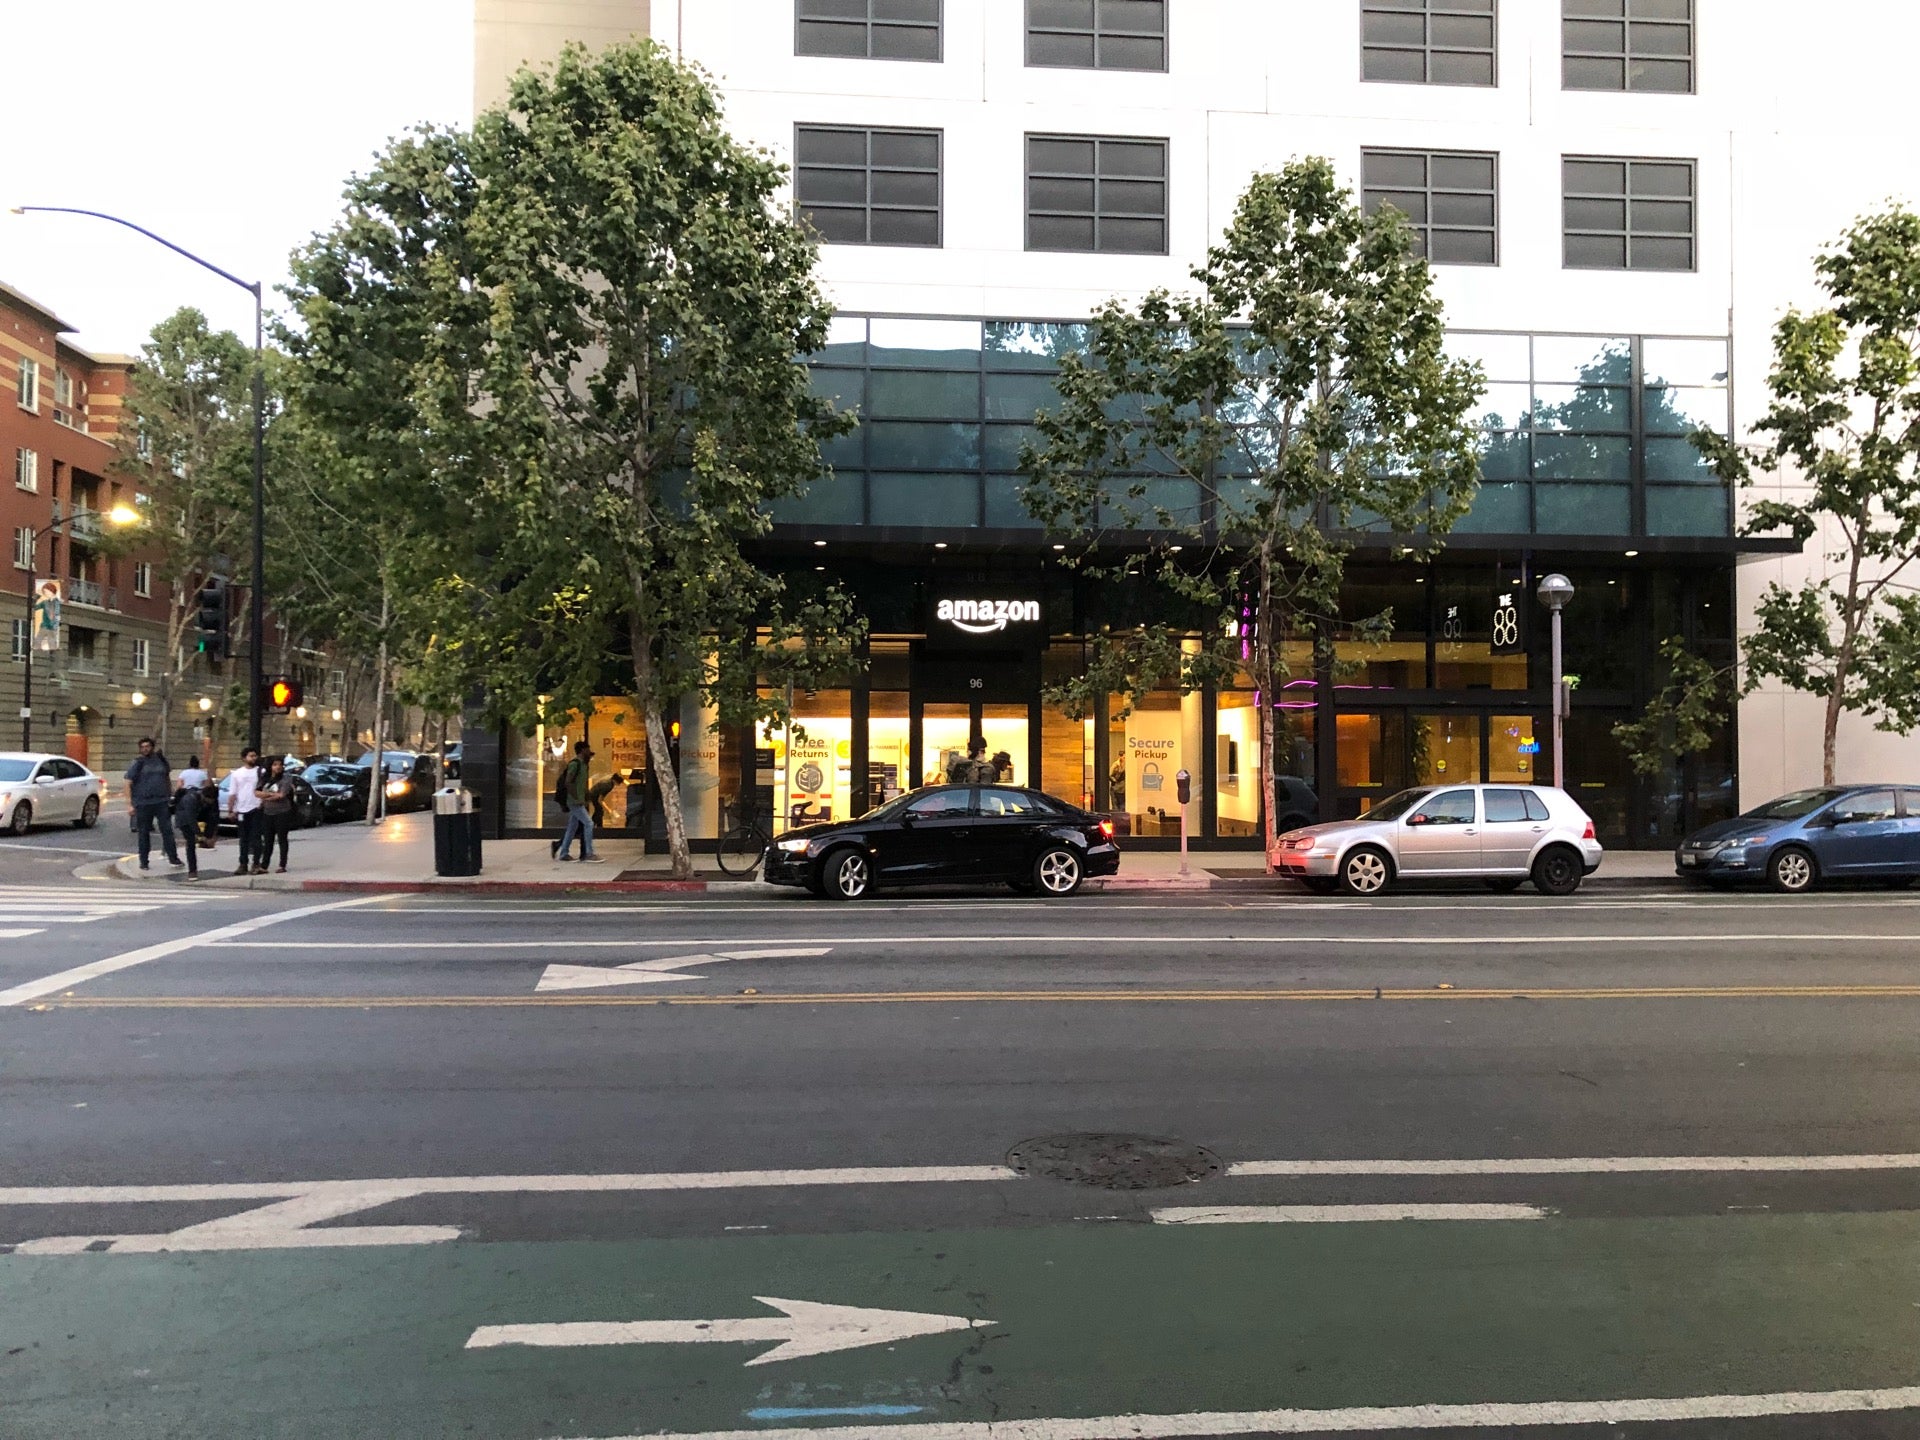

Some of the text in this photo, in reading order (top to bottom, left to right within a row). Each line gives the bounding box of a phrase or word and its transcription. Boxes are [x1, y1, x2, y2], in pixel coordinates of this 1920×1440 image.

[937, 599, 1040, 621] amazon
[1493, 607, 1518, 647] 88
[969, 678, 983, 689] 96
[603, 737, 631, 749] Pick
[1129, 737, 1175, 748] Secure
[680, 750, 716, 760] Pickup
[790, 749, 829, 758] Returns
[1134, 750, 1168, 760] Pickup
